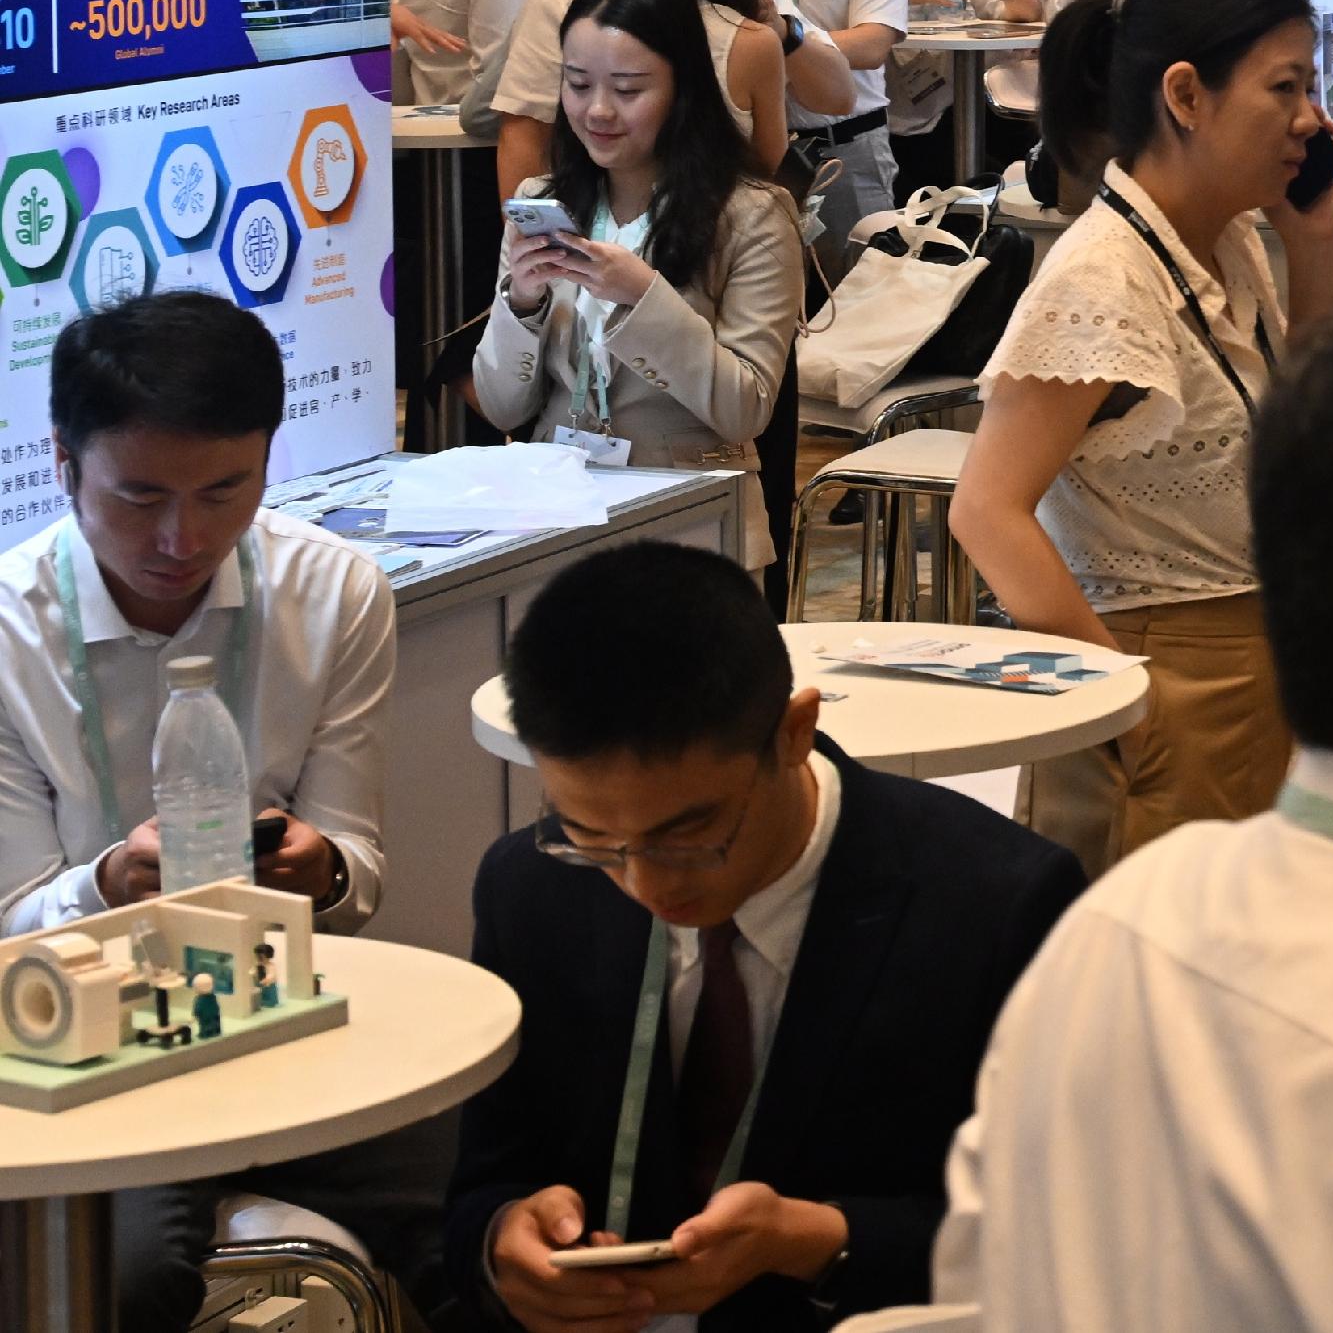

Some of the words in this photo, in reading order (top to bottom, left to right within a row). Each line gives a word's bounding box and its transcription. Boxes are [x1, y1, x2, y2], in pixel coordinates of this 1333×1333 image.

[0, 7, 34, 50] 10
[138, 100, 157, 120] Key
[160, 95, 208, 117] Research
[211, 91, 240, 109] Areas
